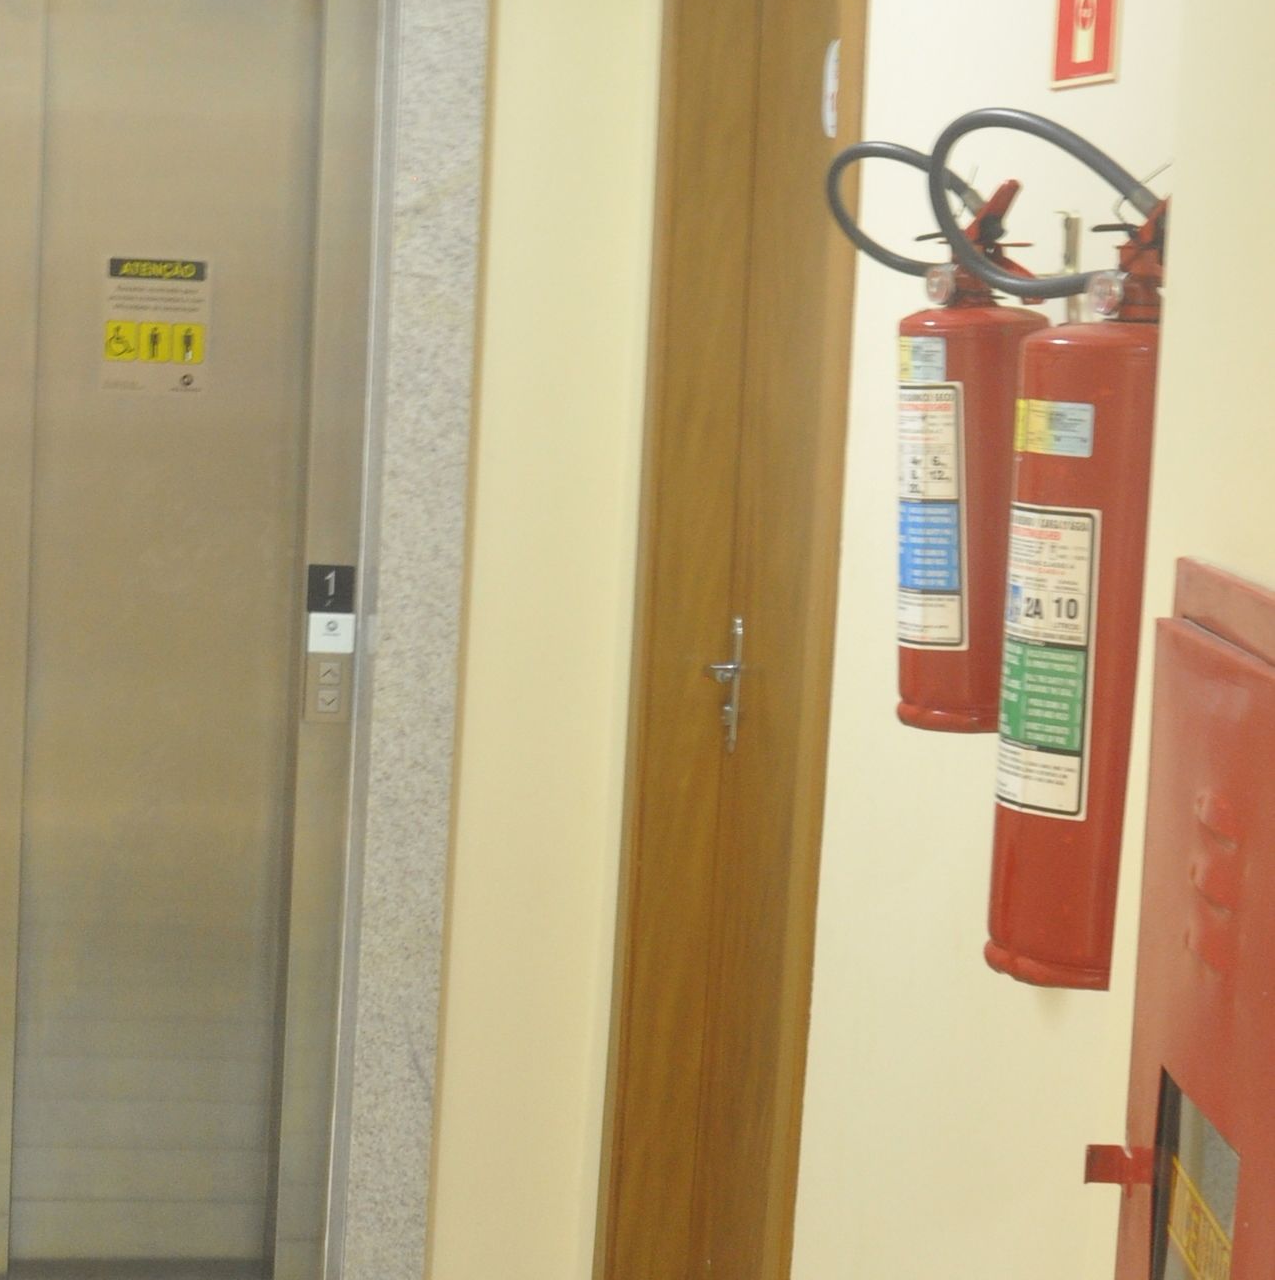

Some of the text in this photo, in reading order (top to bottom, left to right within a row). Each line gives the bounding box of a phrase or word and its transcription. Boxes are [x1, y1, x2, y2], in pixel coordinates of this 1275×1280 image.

[119, 261, 197, 279] ATENÇÃO
[325, 571, 335, 596] 1
[1025, 597, 1044, 619] 2A
[1053, 597, 1078, 619] 10
